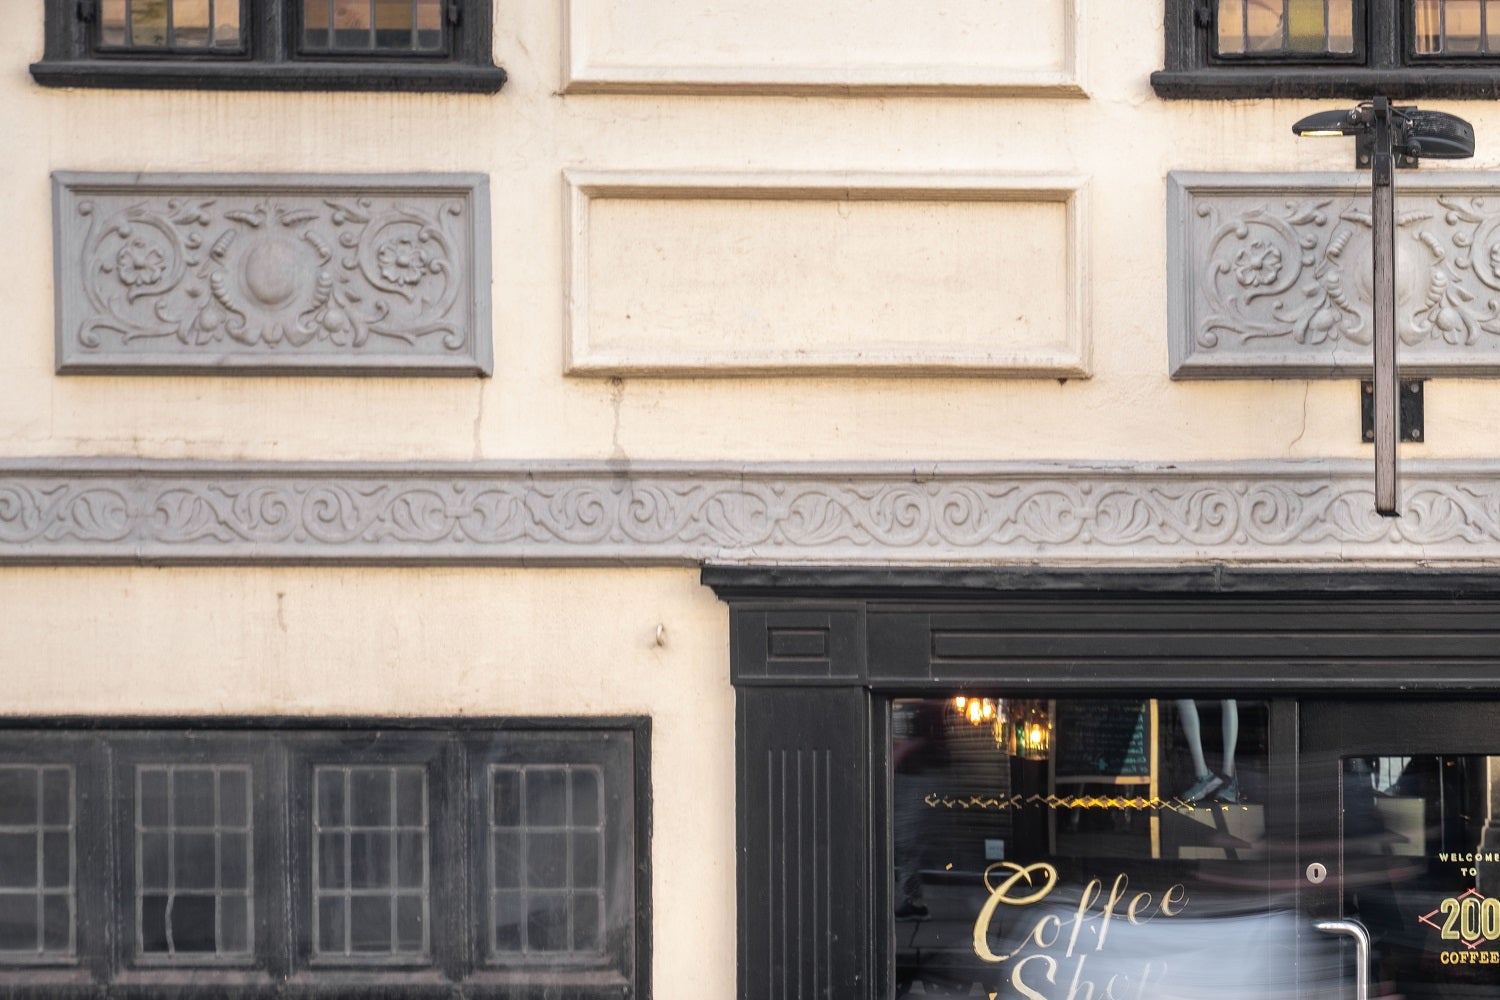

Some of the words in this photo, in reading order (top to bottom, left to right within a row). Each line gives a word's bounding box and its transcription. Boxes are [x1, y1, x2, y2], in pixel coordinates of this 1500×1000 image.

[1439, 852, 1500, 863] WELCOME
[1460, 867, 1478, 877] TO
[973, 861, 1190, 963] Coffee
[1440, 950, 1500, 965] COFFEE
